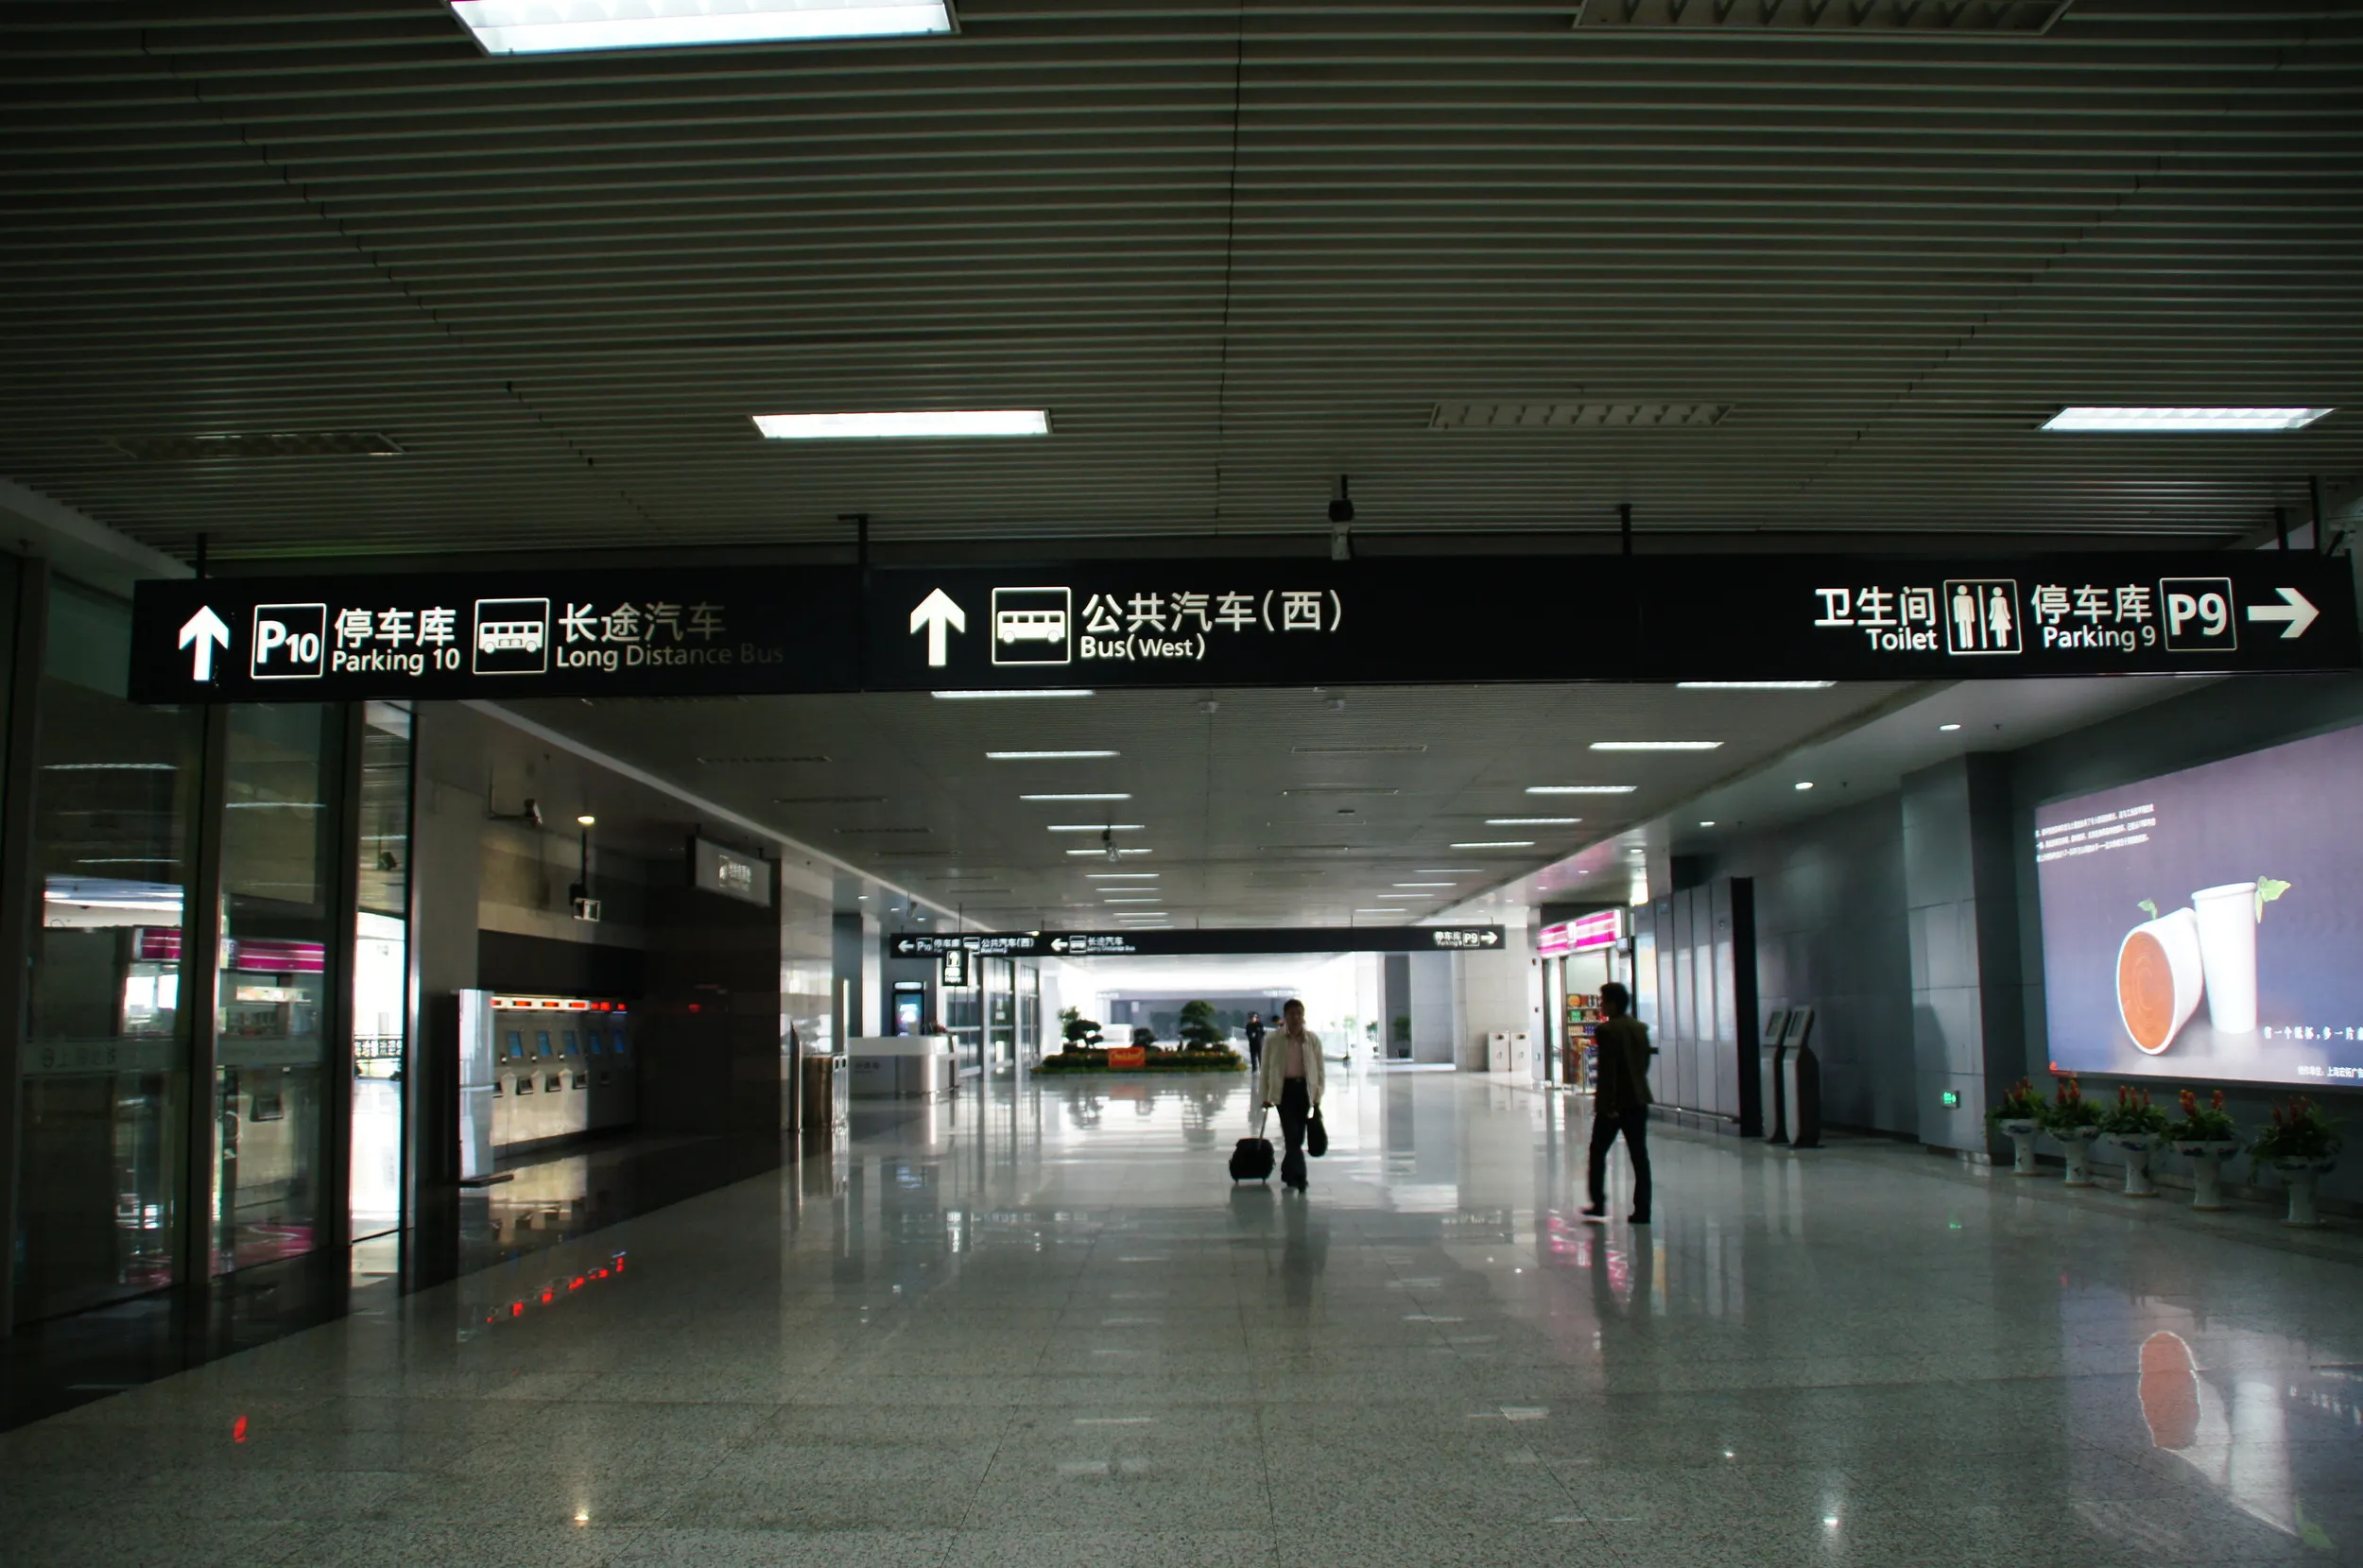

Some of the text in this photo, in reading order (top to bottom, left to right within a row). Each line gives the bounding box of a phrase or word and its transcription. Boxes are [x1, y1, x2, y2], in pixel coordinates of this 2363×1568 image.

[557, 600, 727, 644] 长途汽车
[1081, 589, 1342, 632] 公共汽车(西)
[1814, 585, 1937, 627] 卫生间
[2030, 583, 2153, 625] 停车库
[2167, 594, 2228, 636] P9
[255, 619, 320, 664] P10
[334, 606, 457, 649] 停车库
[1864, 627, 1939, 651] Toilet
[2043, 626, 2156, 652] Parking 9
[332, 647, 460, 677] Parking 10
[556, 643, 784, 673] Long Distance Bus
[1464, 932, 1478, 943] P9
